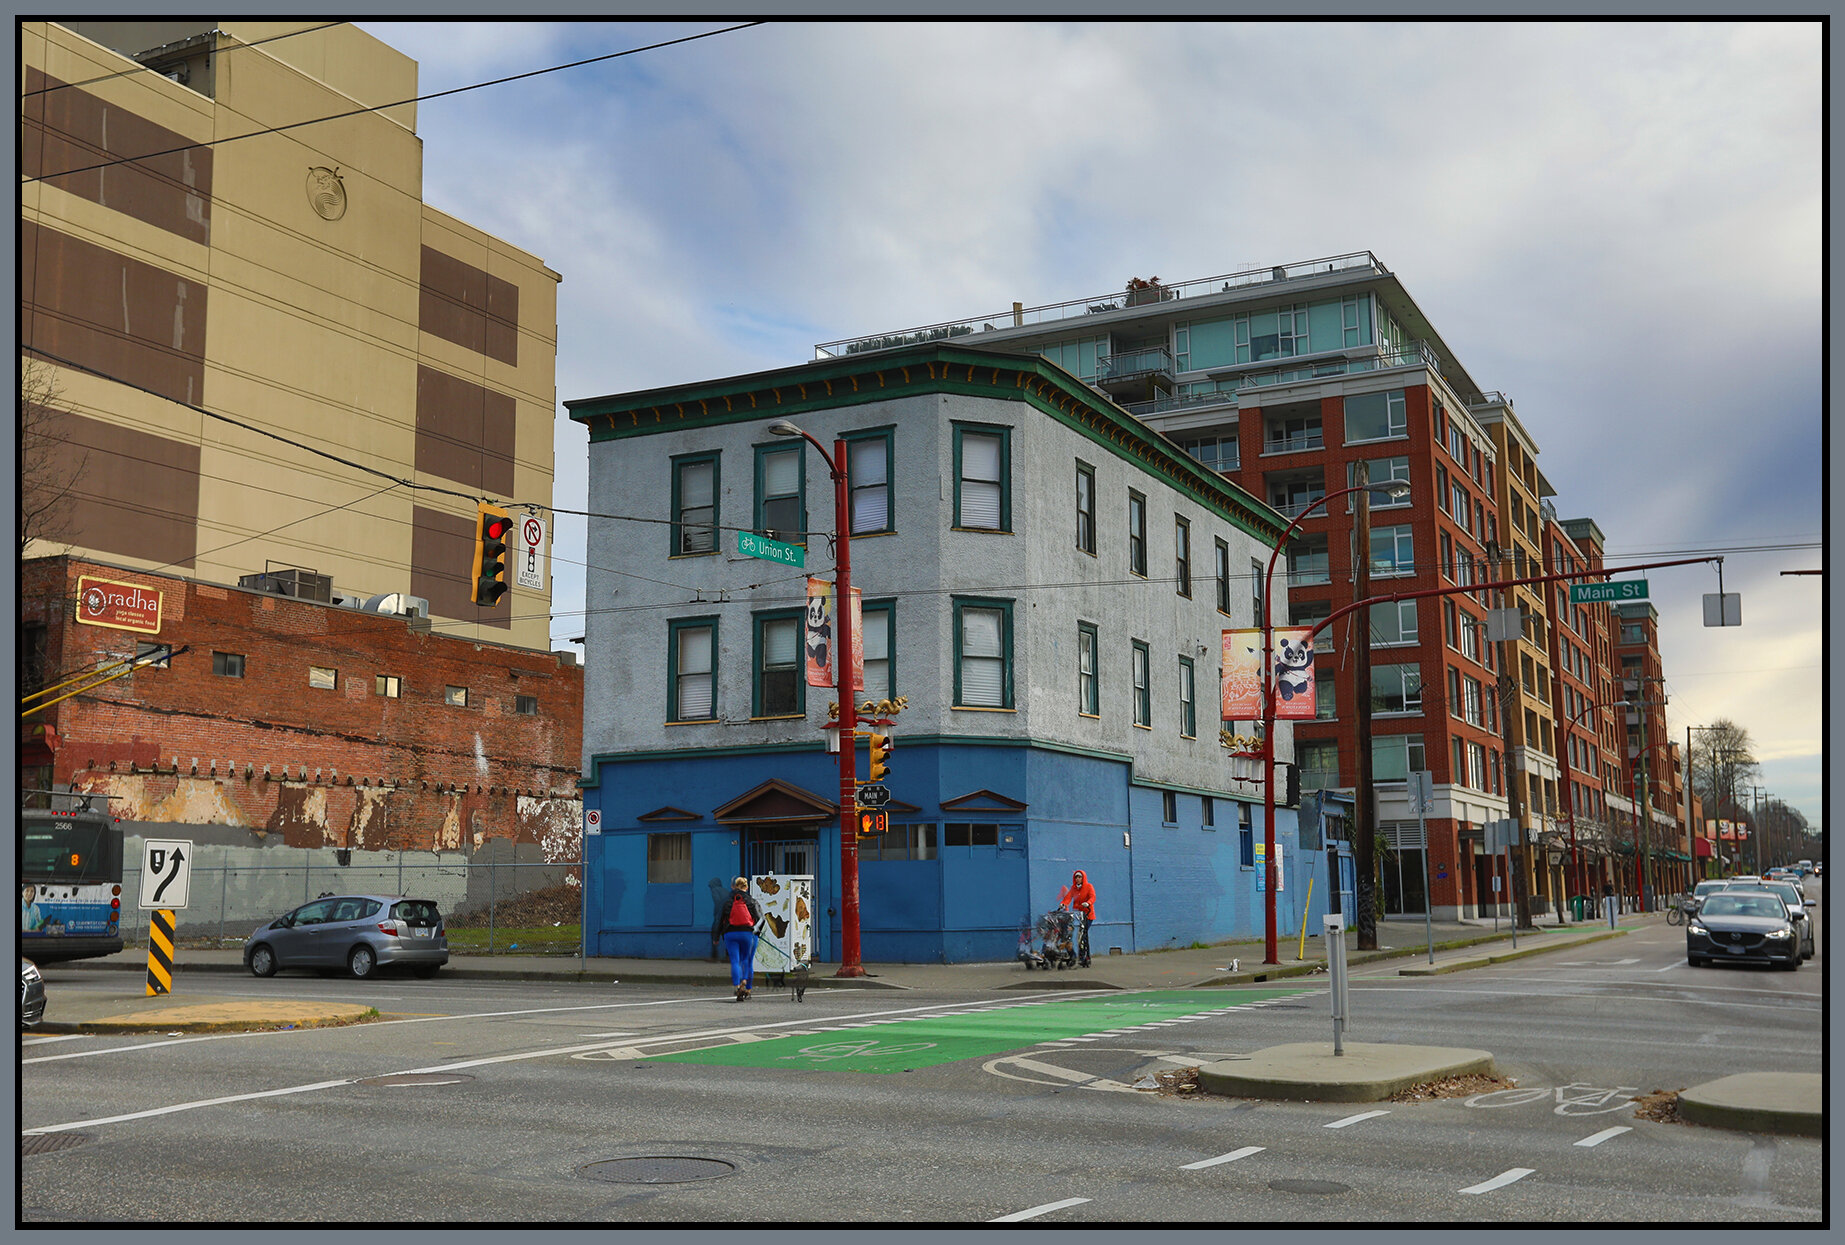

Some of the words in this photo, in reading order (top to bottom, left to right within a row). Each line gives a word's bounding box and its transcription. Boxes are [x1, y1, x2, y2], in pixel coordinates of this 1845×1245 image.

[759, 541, 782, 559] Union
[785, 547, 797, 562] St.
[521, 571, 540, 580] EXCEPT
[519, 577, 541, 588] BICYCLES
[1577, 586, 1615, 600] Main
[1622, 584, 1640, 597] St
[108, 589, 157, 611] radha
[864, 792, 878, 800] MAIN
[54, 822, 73, 831] 2566
[876, 814, 885, 831] 13
[71, 854, 80, 866] 8
